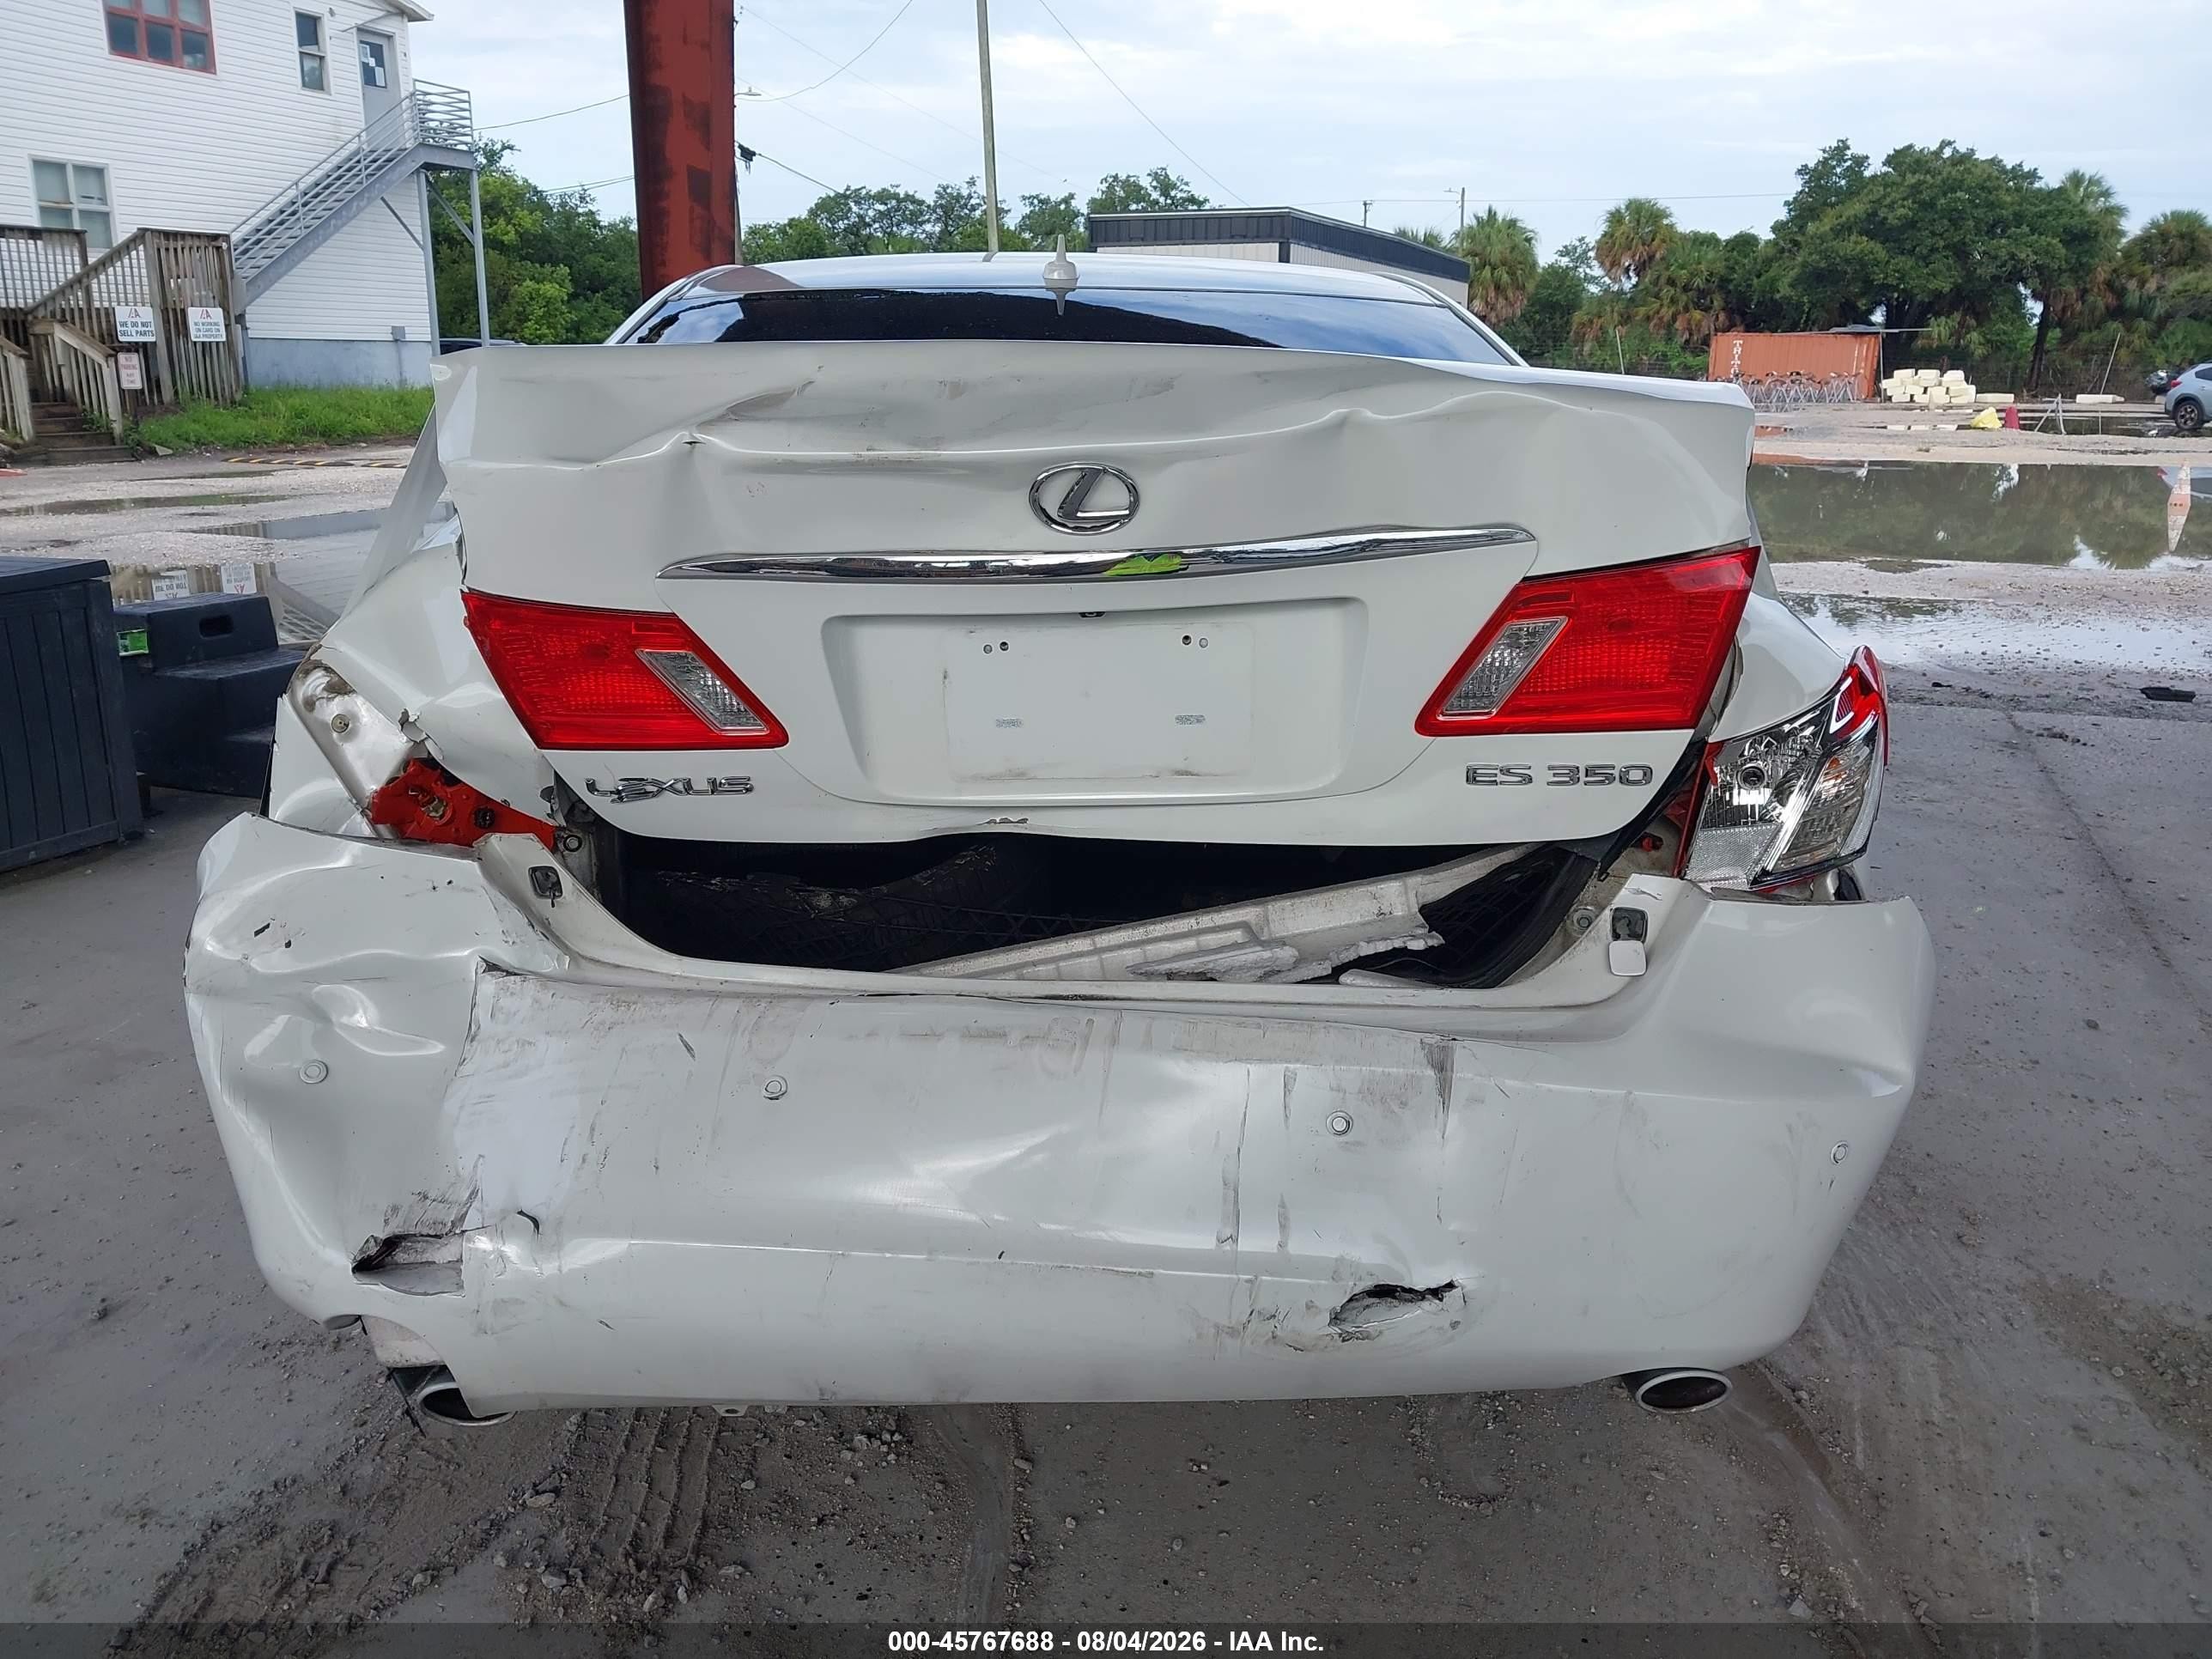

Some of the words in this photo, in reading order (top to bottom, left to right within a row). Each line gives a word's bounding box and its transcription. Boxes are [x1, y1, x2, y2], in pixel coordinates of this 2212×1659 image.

[135, 329, 155, 337] PARTS
[1465, 763, 1534, 787] ES
[1547, 763, 1654, 787] 350
[585, 775, 755, 804] LEXUS
